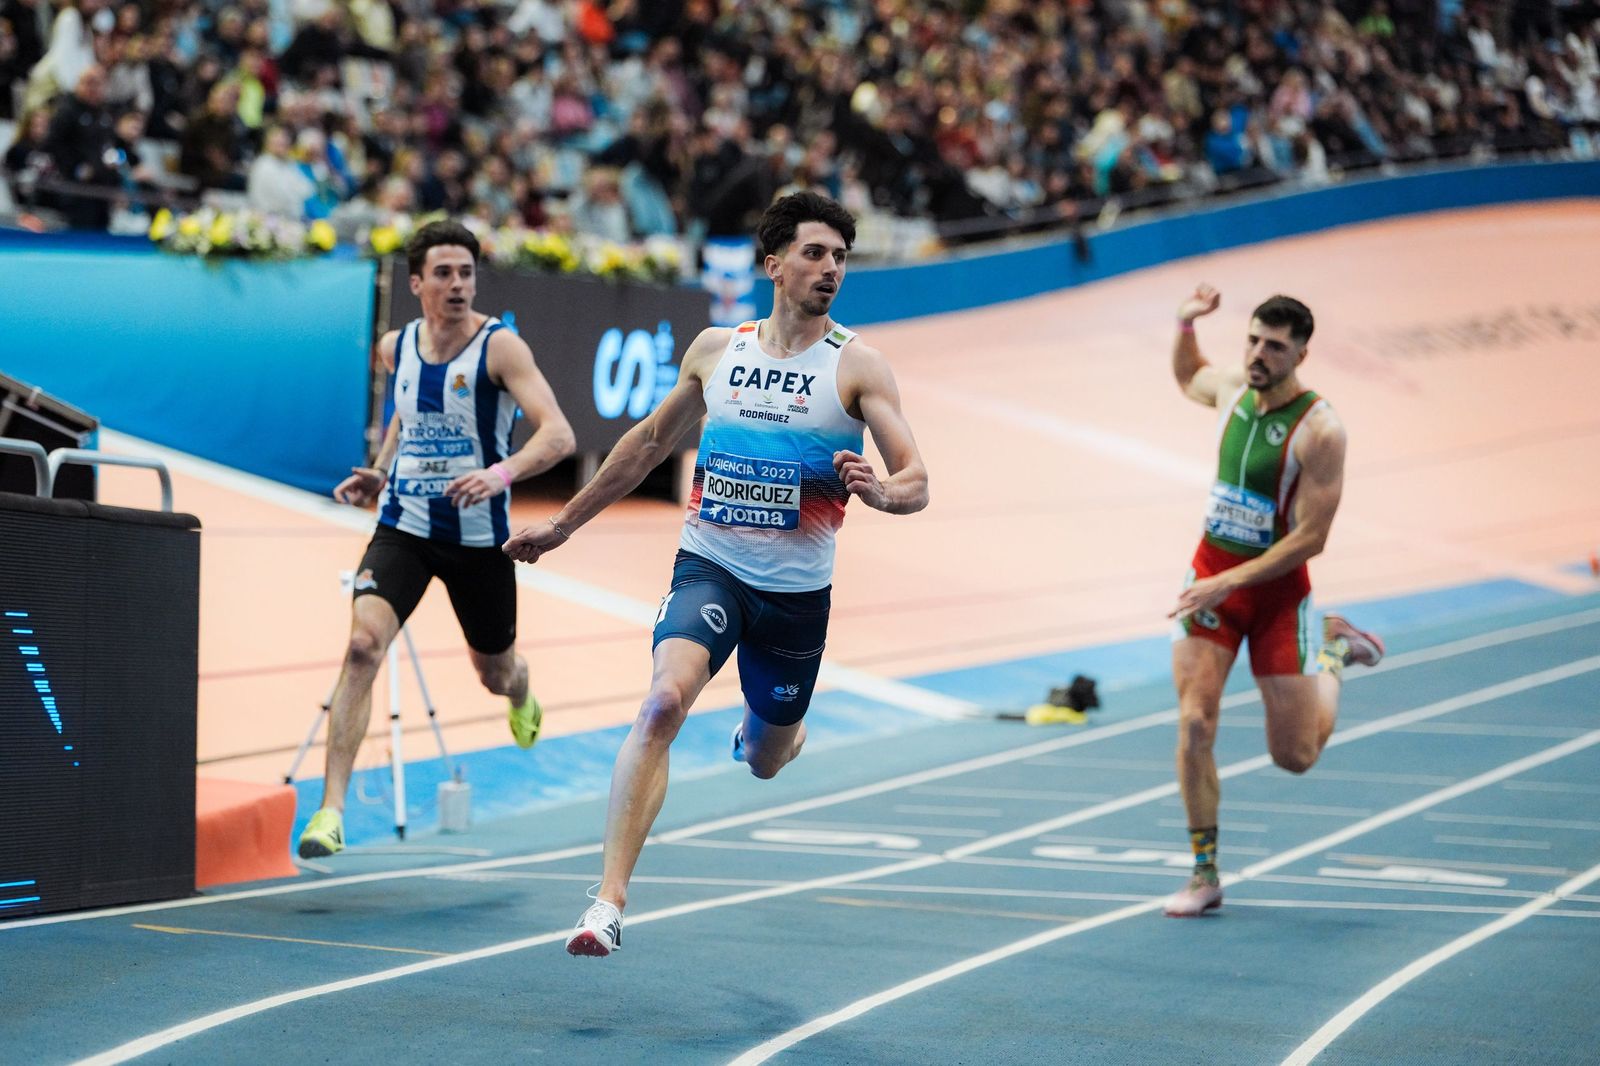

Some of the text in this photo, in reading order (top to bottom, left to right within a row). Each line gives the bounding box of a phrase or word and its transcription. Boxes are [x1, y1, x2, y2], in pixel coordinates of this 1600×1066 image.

[729, 365, 817, 396] CAPEX
[739, 409, 790, 424] RODRÍGUEZ
[761, 466, 795, 480] 2027
[707, 475, 794, 505] RODRIGUEZ
